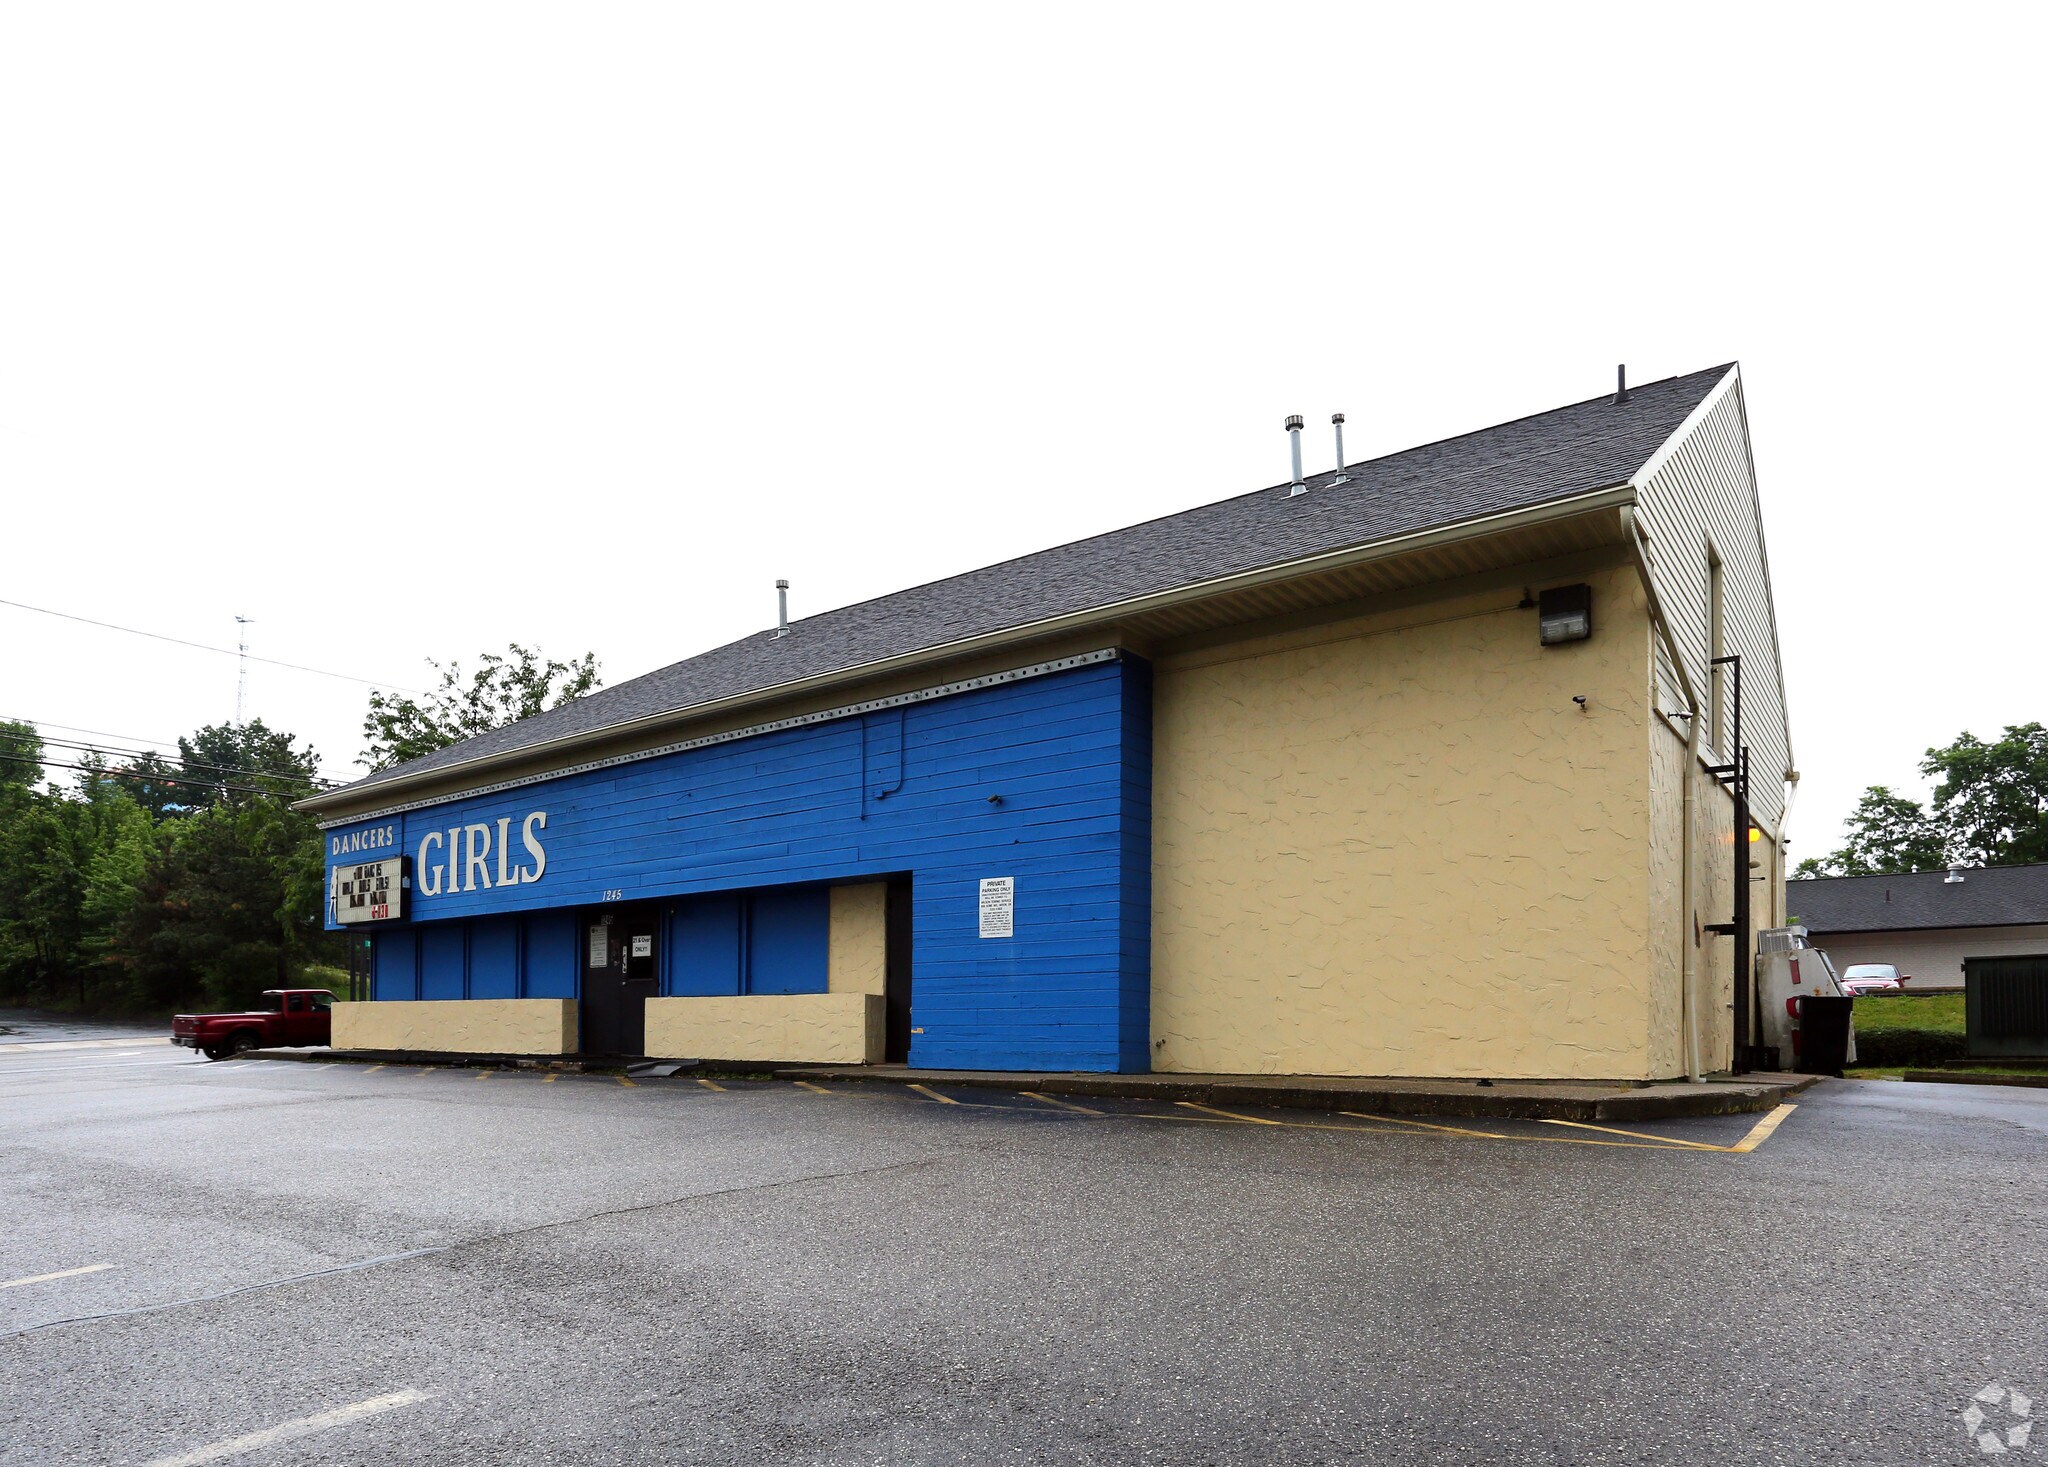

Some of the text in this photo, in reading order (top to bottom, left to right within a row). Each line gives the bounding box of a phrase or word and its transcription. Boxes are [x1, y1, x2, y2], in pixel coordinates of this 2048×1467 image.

[332, 825, 393, 856] DANCERS
[417, 811, 547, 897] GIRLS
[602, 889, 622, 902] 1245
